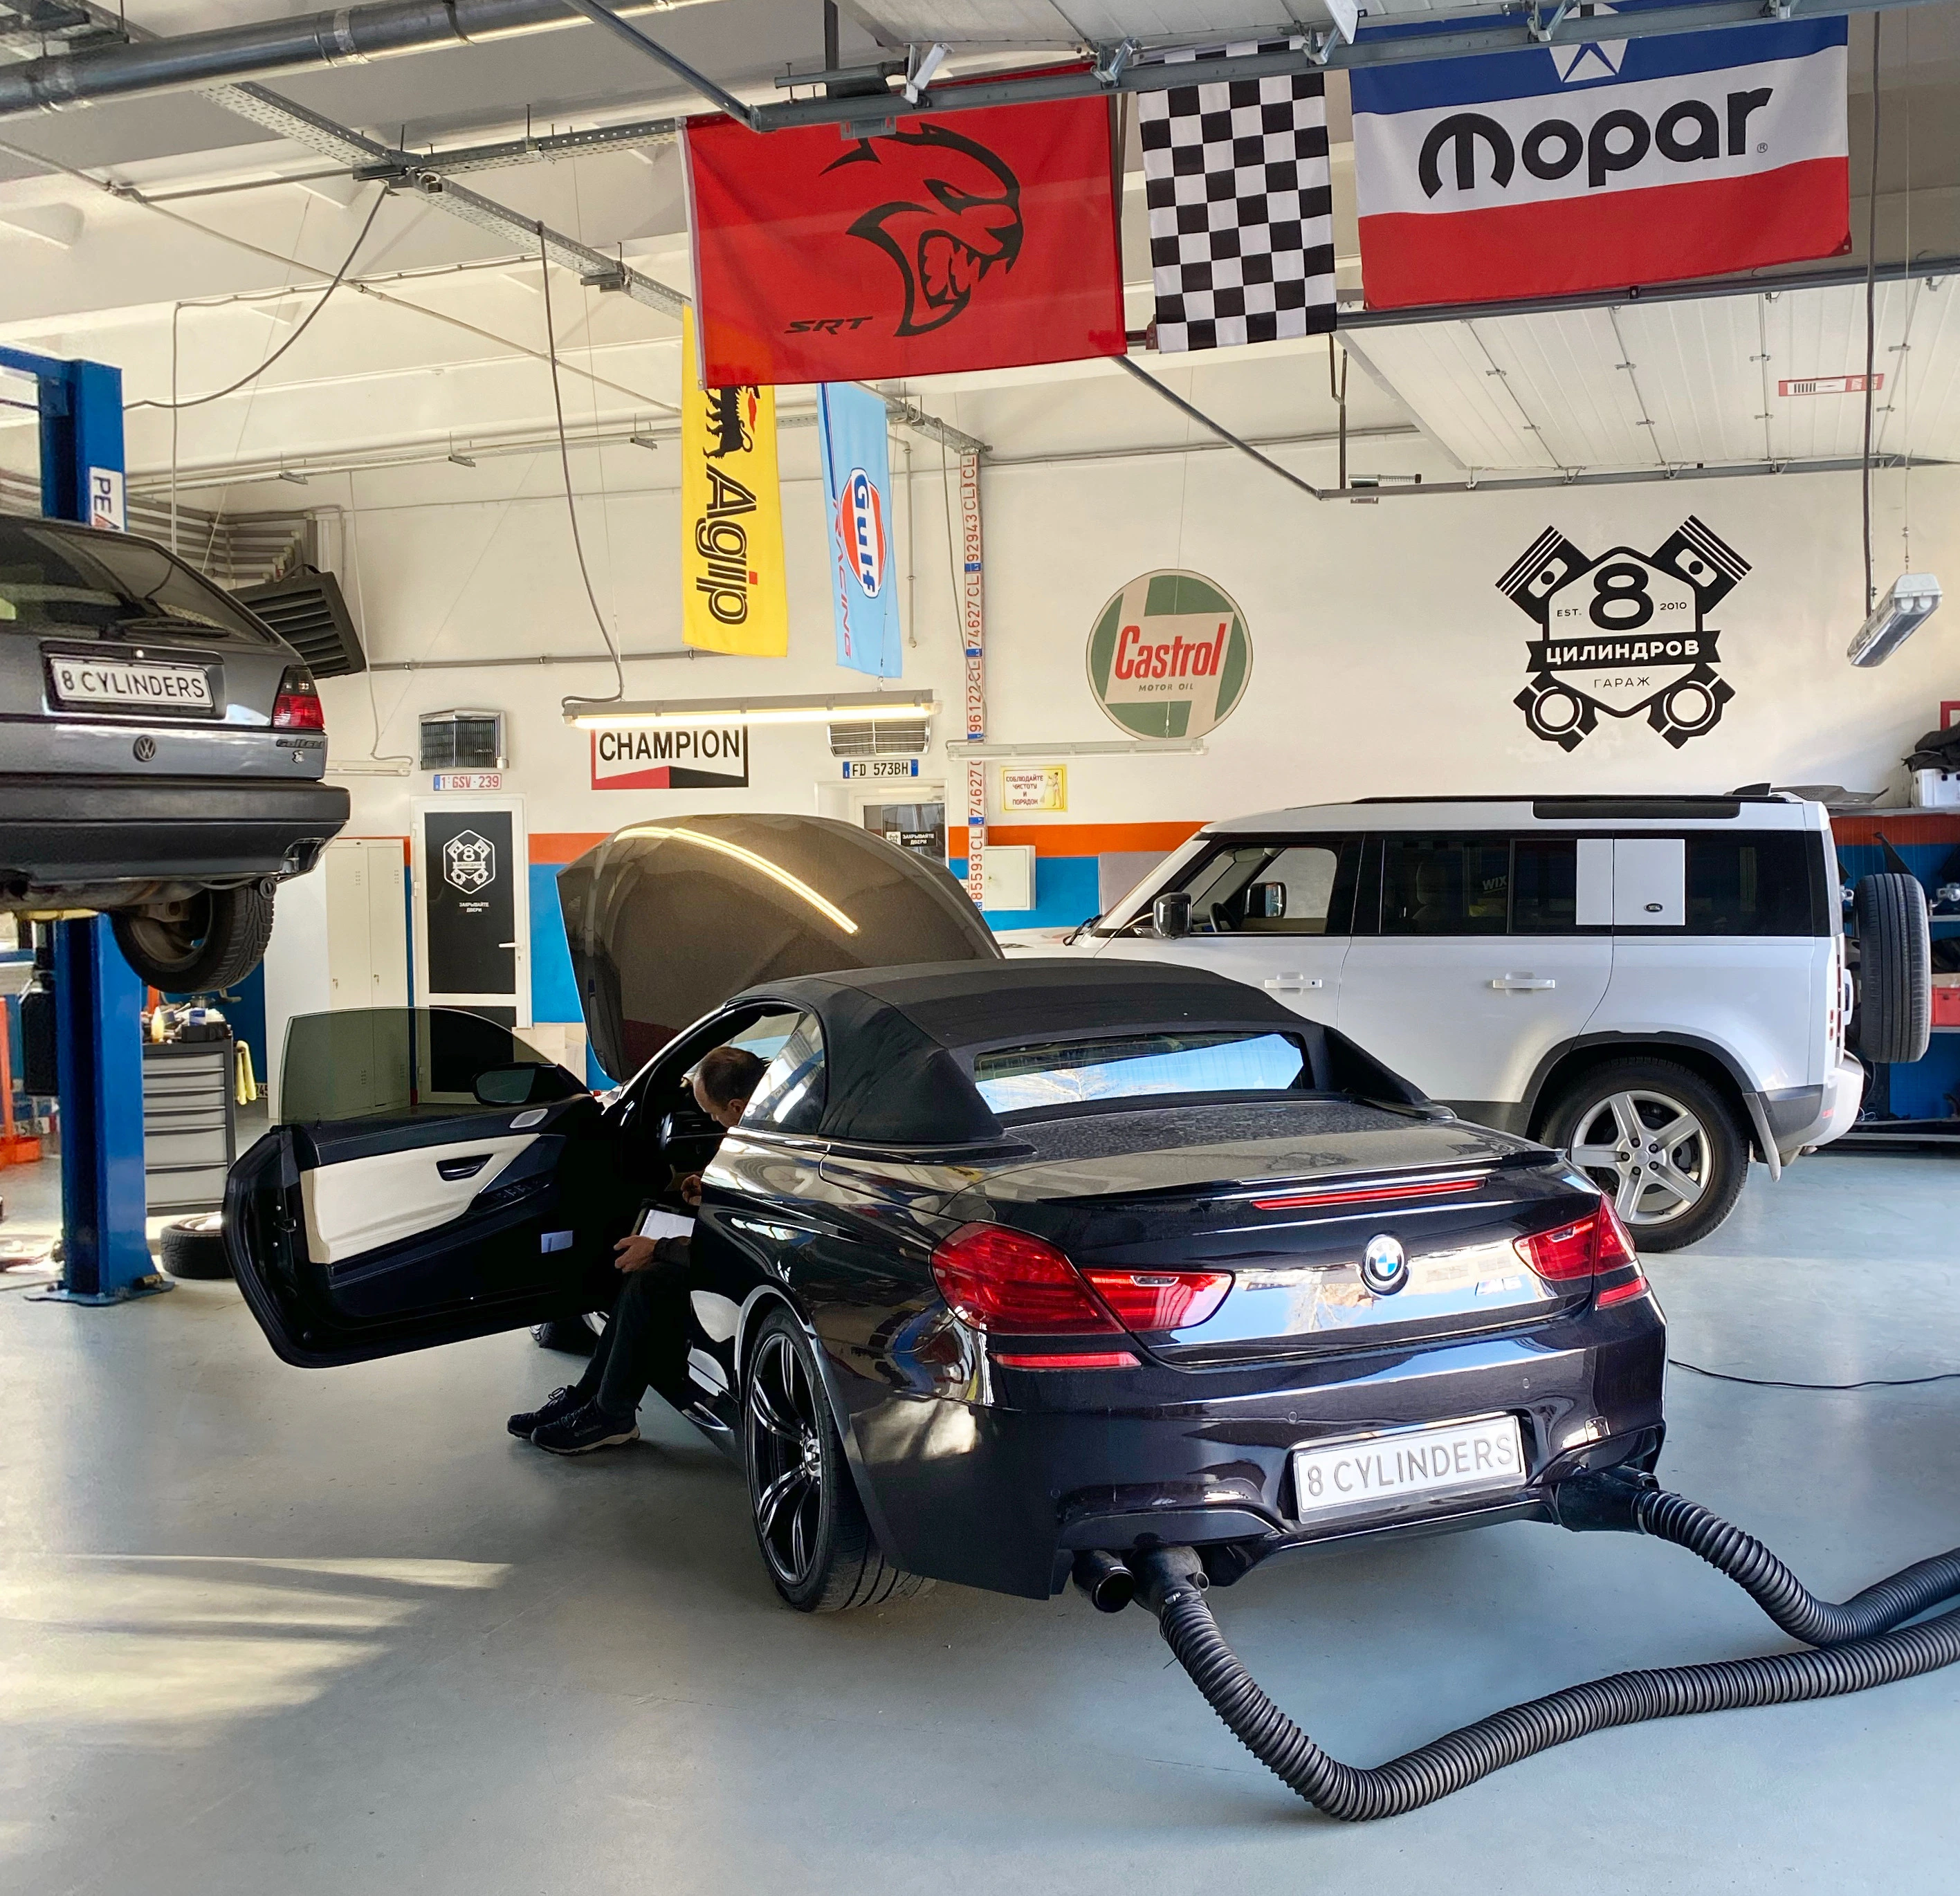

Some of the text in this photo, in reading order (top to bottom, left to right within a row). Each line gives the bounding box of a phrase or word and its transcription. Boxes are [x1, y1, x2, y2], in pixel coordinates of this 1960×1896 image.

[783, 315, 873, 335] SRT
[962, 488, 976, 510] CL
[695, 462, 758, 625] Agip
[854, 474, 876, 593] Gulf
[964, 514, 979, 562] 92943
[967, 575, 980, 596] CL
[1589, 562, 1654, 631] 8
[1557, 609, 1582, 617] EST.
[1660, 602, 1687, 610] 2010
[967, 600, 980, 647] 74627
[1115, 623, 1227, 680] Castrol
[1546, 640, 1699, 665] ЦИЛИНДРОВ
[61, 670, 205, 698] 8 CYLINDERS
[1138, 683, 1173, 692] MOTOR
[1594, 677, 1650, 688] ГАРАЖ
[969, 660, 982, 733] 96122 CL
[599, 729, 740, 761] CHAMPION
[852, 764, 866, 776] FD
[970, 769, 982, 816] 74627
[971, 829, 983, 850] CL
[463, 847, 475, 861] 8
[971, 854, 982, 901] 85593
[1482, 875, 1507, 890] WIX
[1307, 1435, 1514, 1497] 8 CYLINDERS
